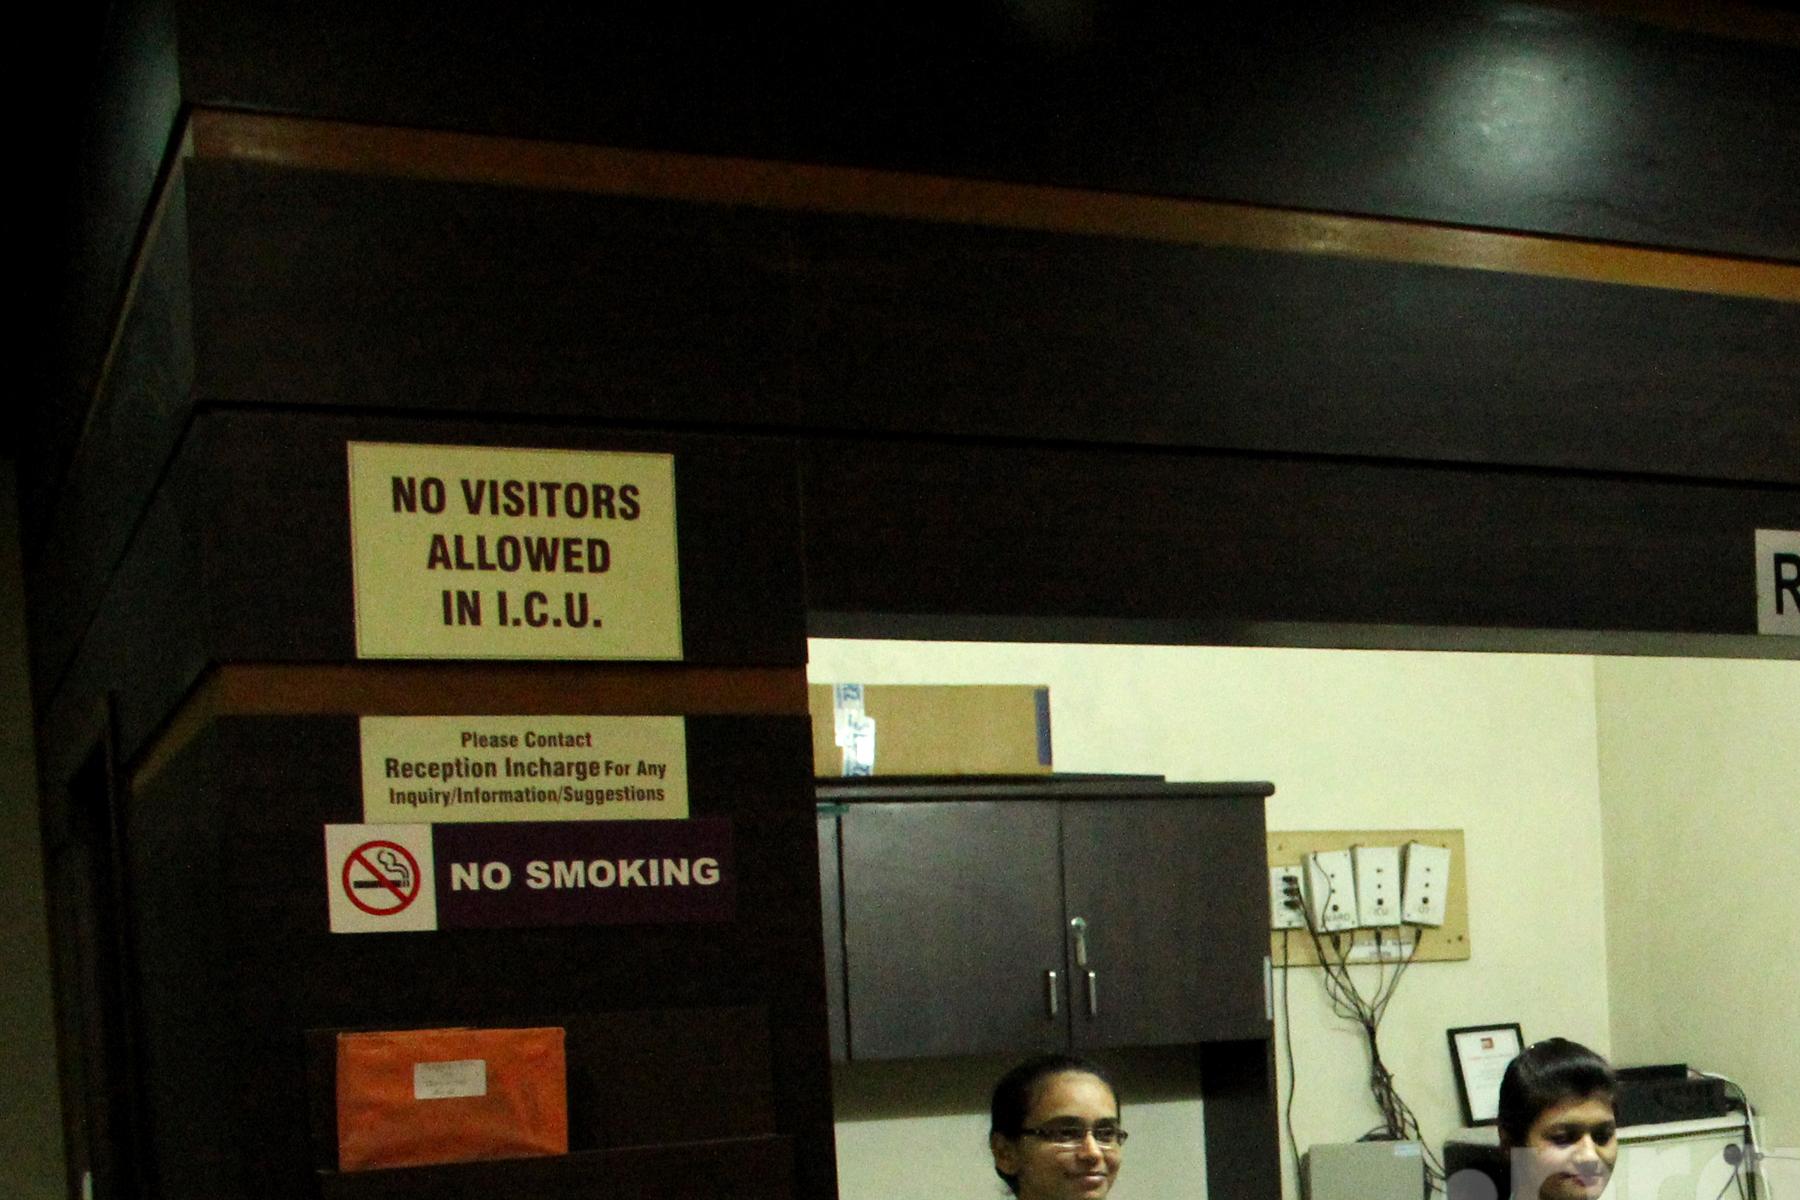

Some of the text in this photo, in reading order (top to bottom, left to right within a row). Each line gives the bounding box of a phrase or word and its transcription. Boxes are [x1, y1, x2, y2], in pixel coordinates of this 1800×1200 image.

[391, 477, 640, 519] NO VISITORS
[428, 535, 610, 574] ALLOWED
[442, 591, 602, 628] IN I.C.U.
[461, 732, 592, 748] Please Contact
[385, 758, 666, 781] Reception Incharge For Any
[389, 786, 665, 807] Inquiry/Information/Suggestions
[450, 857, 720, 890] NO SMOKING
